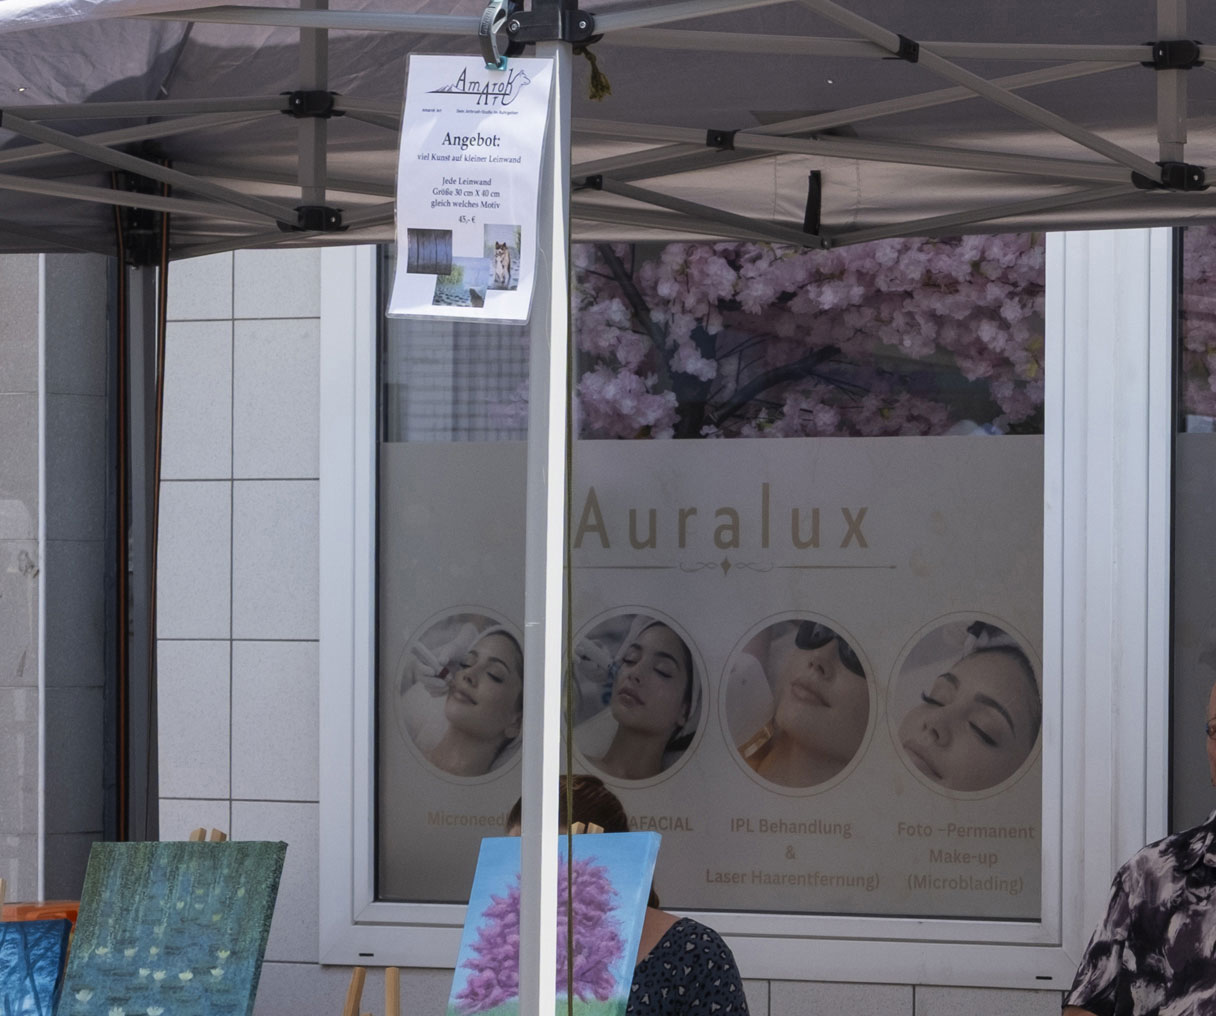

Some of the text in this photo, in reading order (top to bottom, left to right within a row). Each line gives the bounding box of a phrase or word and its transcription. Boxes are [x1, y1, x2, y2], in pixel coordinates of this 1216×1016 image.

[441, 131, 501, 151] Angebot:
[417, 153, 522, 164] viel Kunst auf kleiner Leinwand
[442, 177, 492, 186] Jede Leinwand
[431, 199, 501, 209] gleich welches Motiv
[573, 482, 869, 550] Auralux
[428, 811, 506, 828] Microneed
[730, 817, 853, 839] IPL Behandlung
[897, 821, 933, 838] Foto
[784, 845, 797, 861] &
[929, 848, 999, 869] Make-up
[705, 868, 881, 892] Laser Haarentfernung)
[907, 874, 1024, 895] (Microblading)
